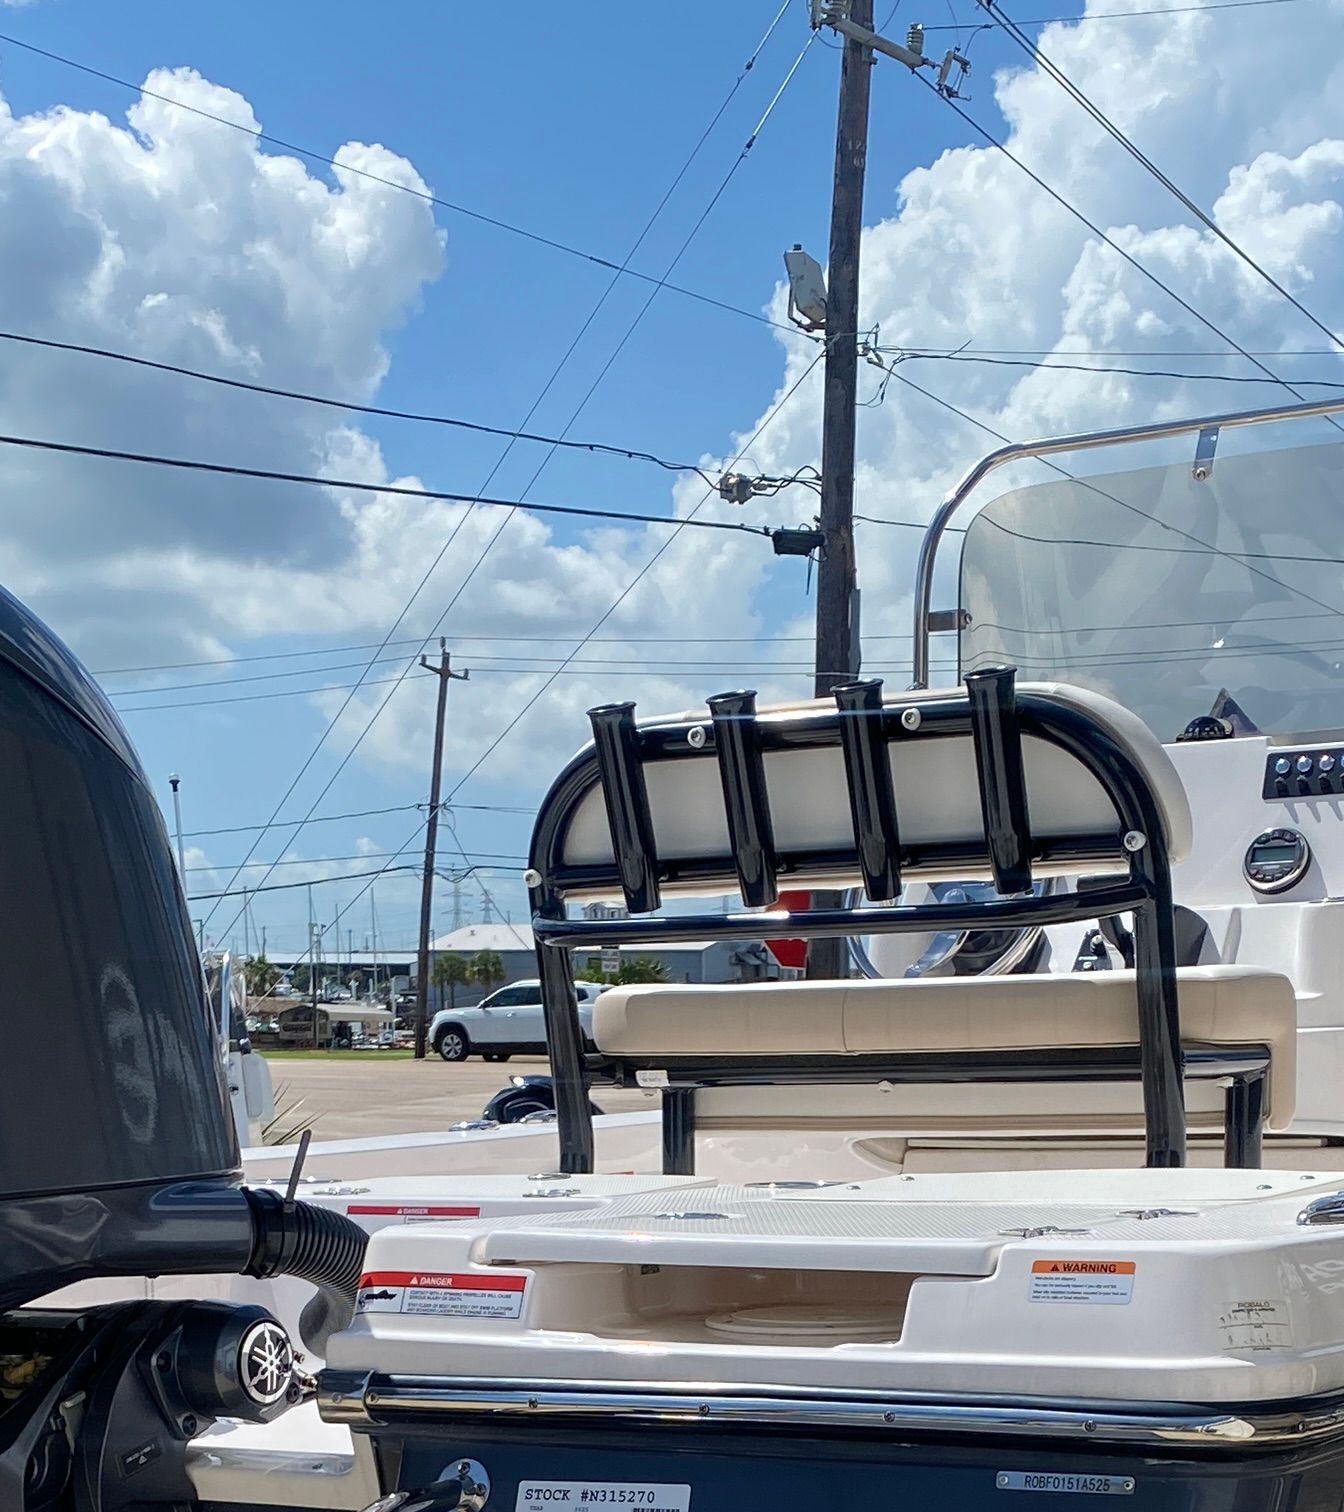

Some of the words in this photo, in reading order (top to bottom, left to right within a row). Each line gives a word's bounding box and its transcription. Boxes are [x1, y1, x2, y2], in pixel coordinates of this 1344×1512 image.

[1063, 1264, 1116, 1273] WARNING
[420, 1277, 453, 1286] DANGER
[525, 1488, 571, 1501] STOCK
[581, 1490, 655, 1504] #N315270
